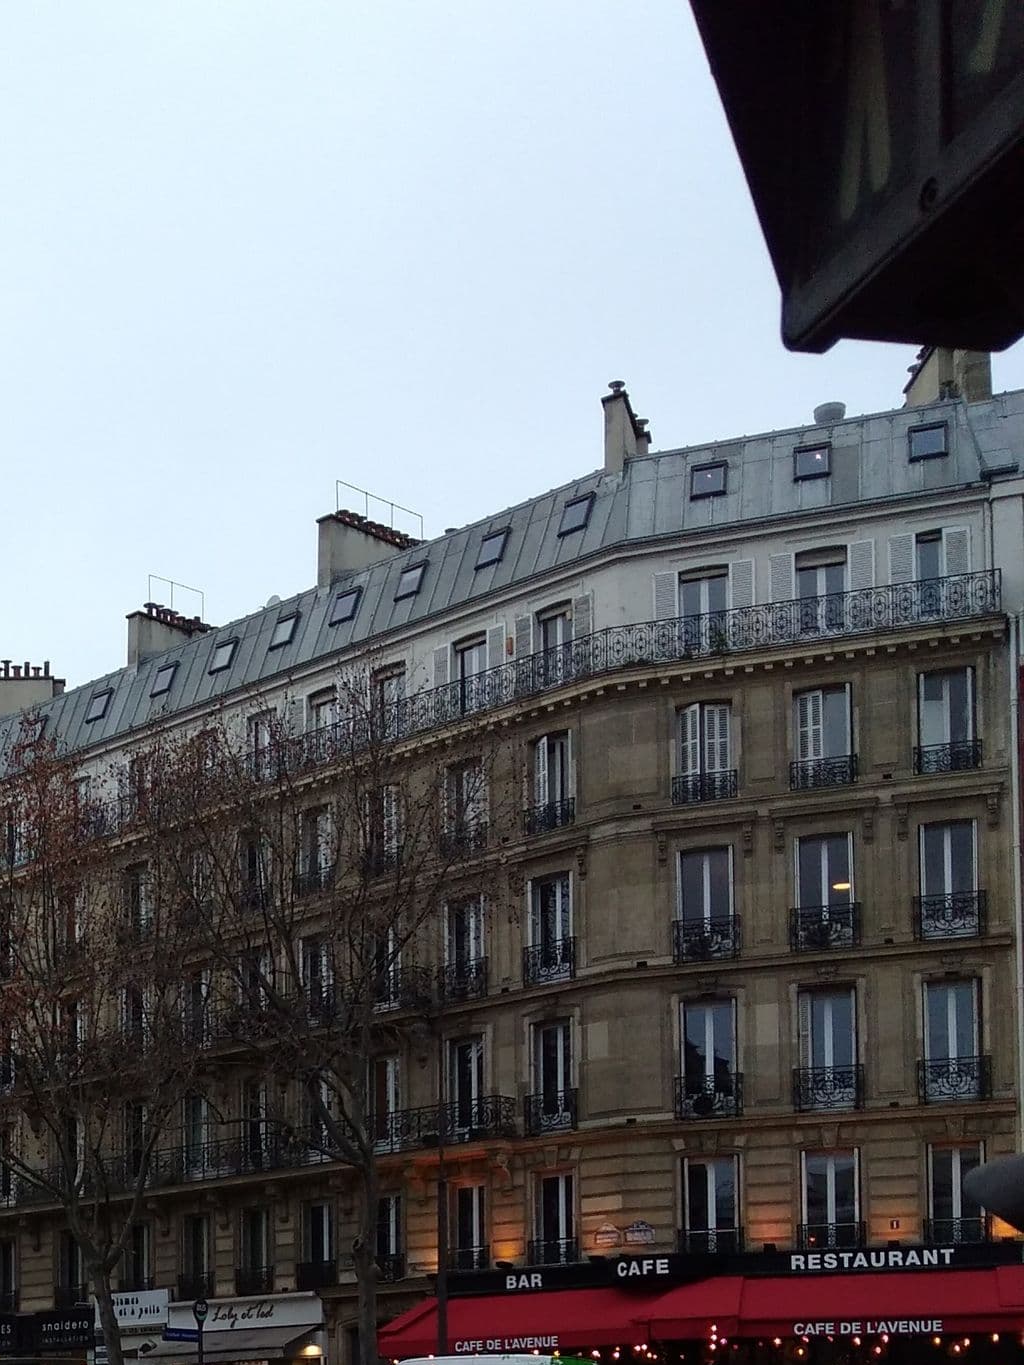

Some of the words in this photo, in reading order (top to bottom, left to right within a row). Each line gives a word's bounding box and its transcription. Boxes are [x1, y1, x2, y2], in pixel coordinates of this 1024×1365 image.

[617, 1259, 670, 1277] CAFE
[791, 1249, 955, 1270] RESTAURANT
[506, 1273, 543, 1290] BAR
[793, 1323, 835, 1335] CAFE
[840, 1322, 862, 1334] DE
[867, 1320, 944, 1334] L'AVENUE
[455, 1340, 484, 1352] CAFE
[487, 1339, 502, 1350] DE
[505, 1336, 559, 1350] L'AVENUE
